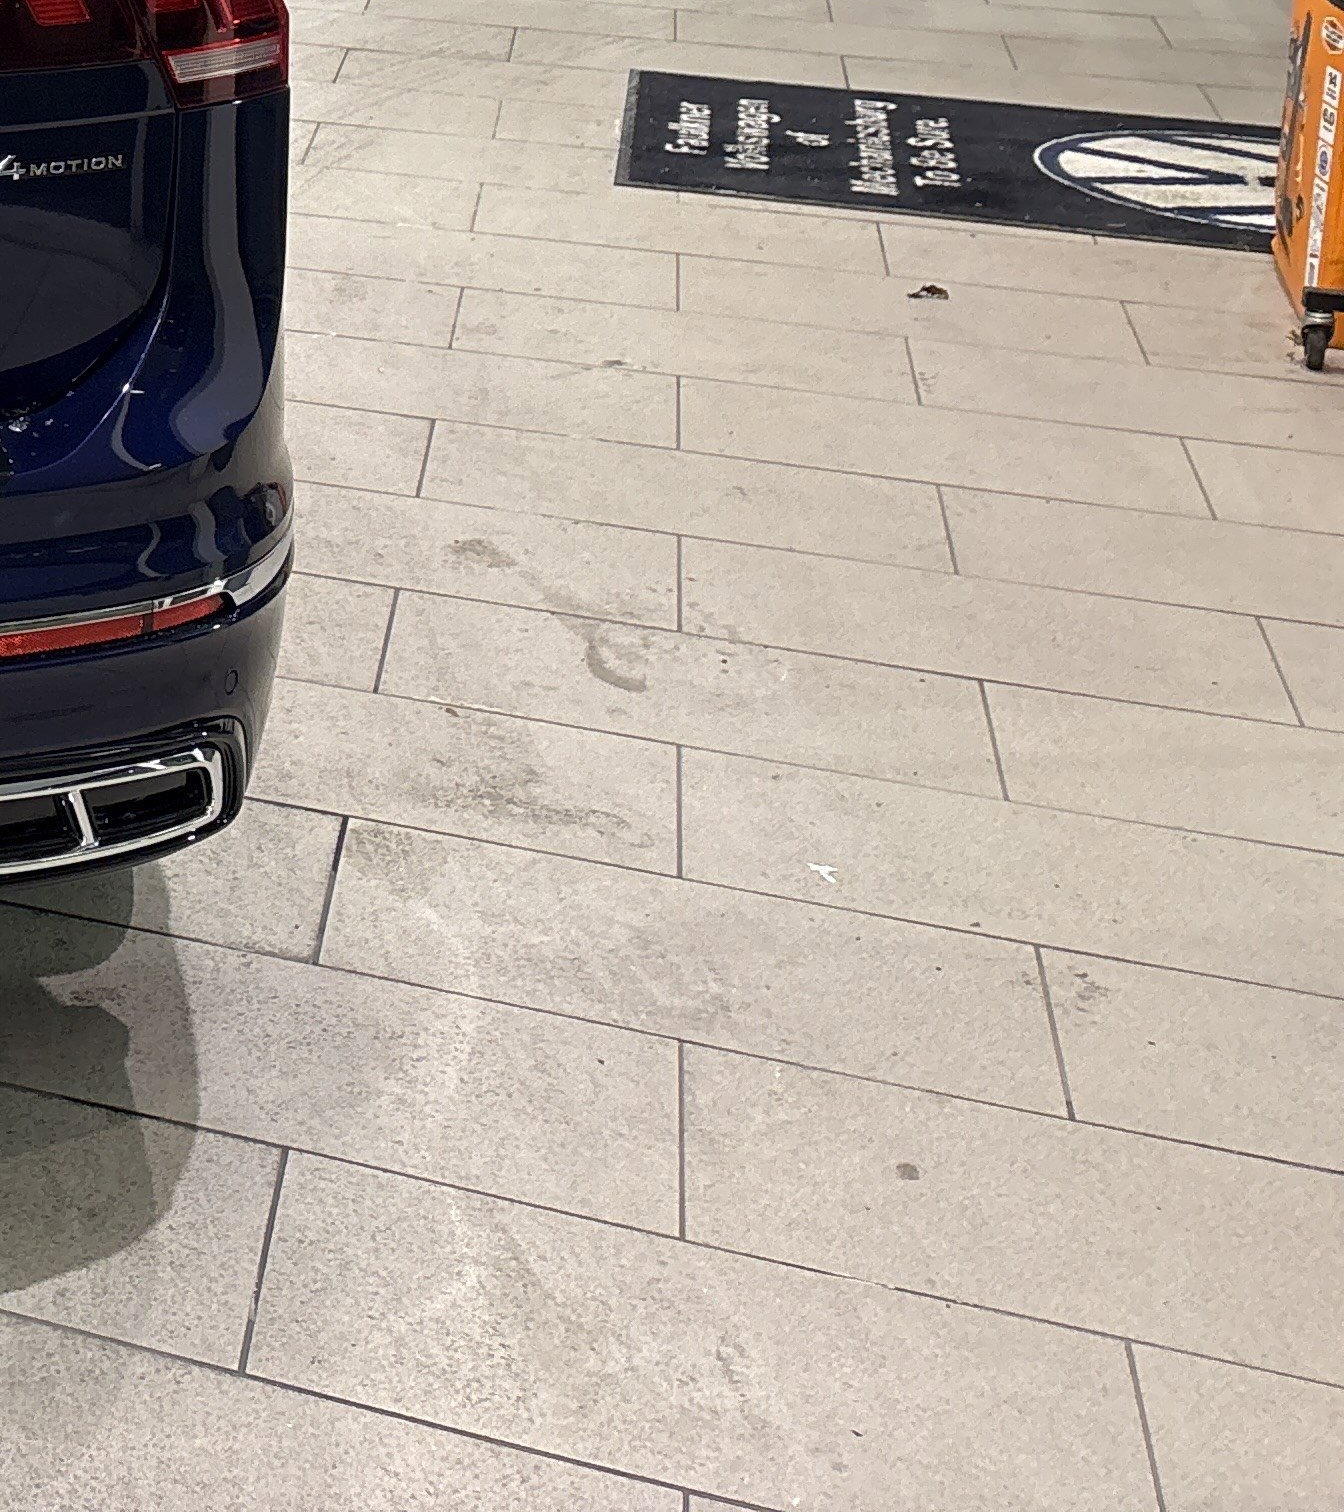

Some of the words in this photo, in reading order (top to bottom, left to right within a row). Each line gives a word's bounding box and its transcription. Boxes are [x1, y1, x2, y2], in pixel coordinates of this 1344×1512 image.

[785, 129, 830, 148] of
[909, 150, 958, 170] Be
[914, 170, 962, 188] To
